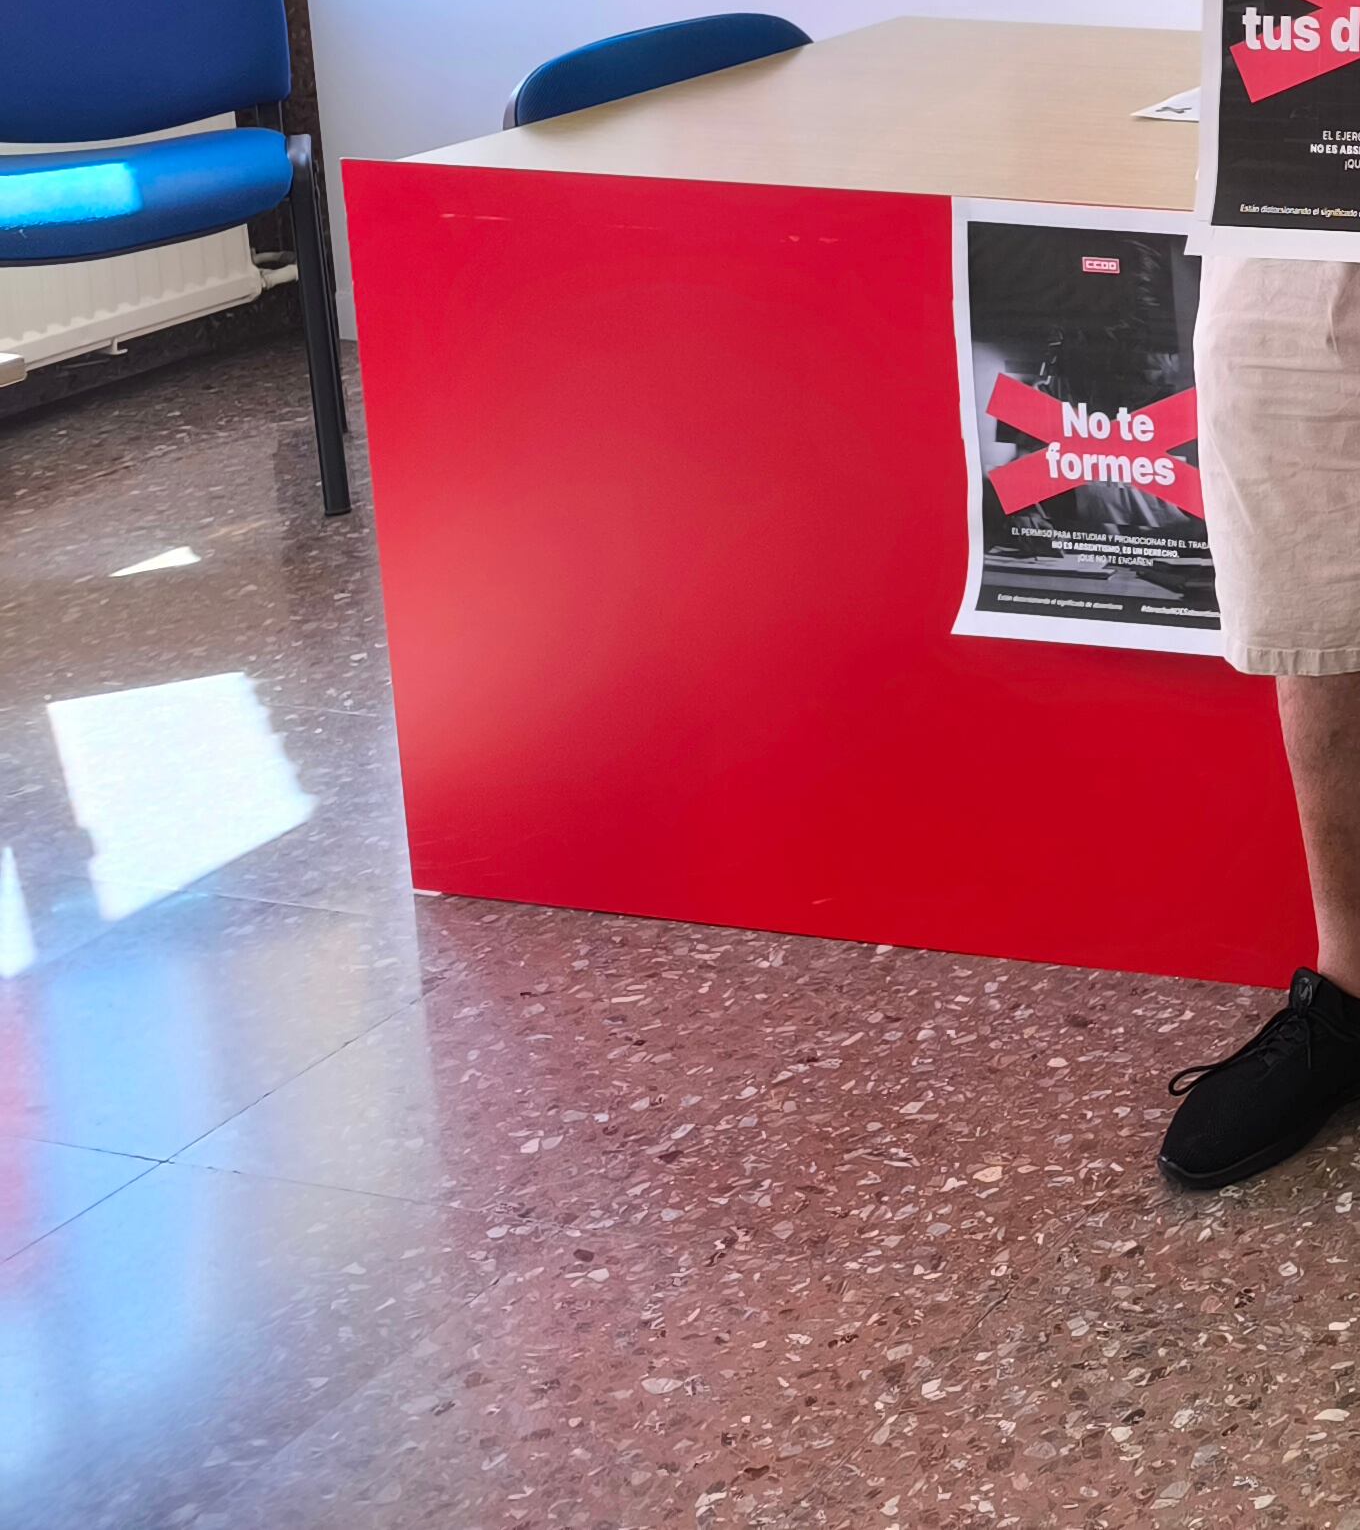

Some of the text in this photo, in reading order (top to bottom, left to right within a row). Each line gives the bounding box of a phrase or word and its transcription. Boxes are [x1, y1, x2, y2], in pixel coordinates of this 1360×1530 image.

[1243, 6, 1320, 52] tus
[1310, 144, 1325, 155] NO
[1325, 144, 1338, 155] ES
[1323, 130, 1333, 141] EL
[1061, 402, 1154, 442] No te
[1046, 441, 1176, 486] formes
[1011, 527, 1187, 548] EL PERMISO PARA ESTUDIAR EN EL
